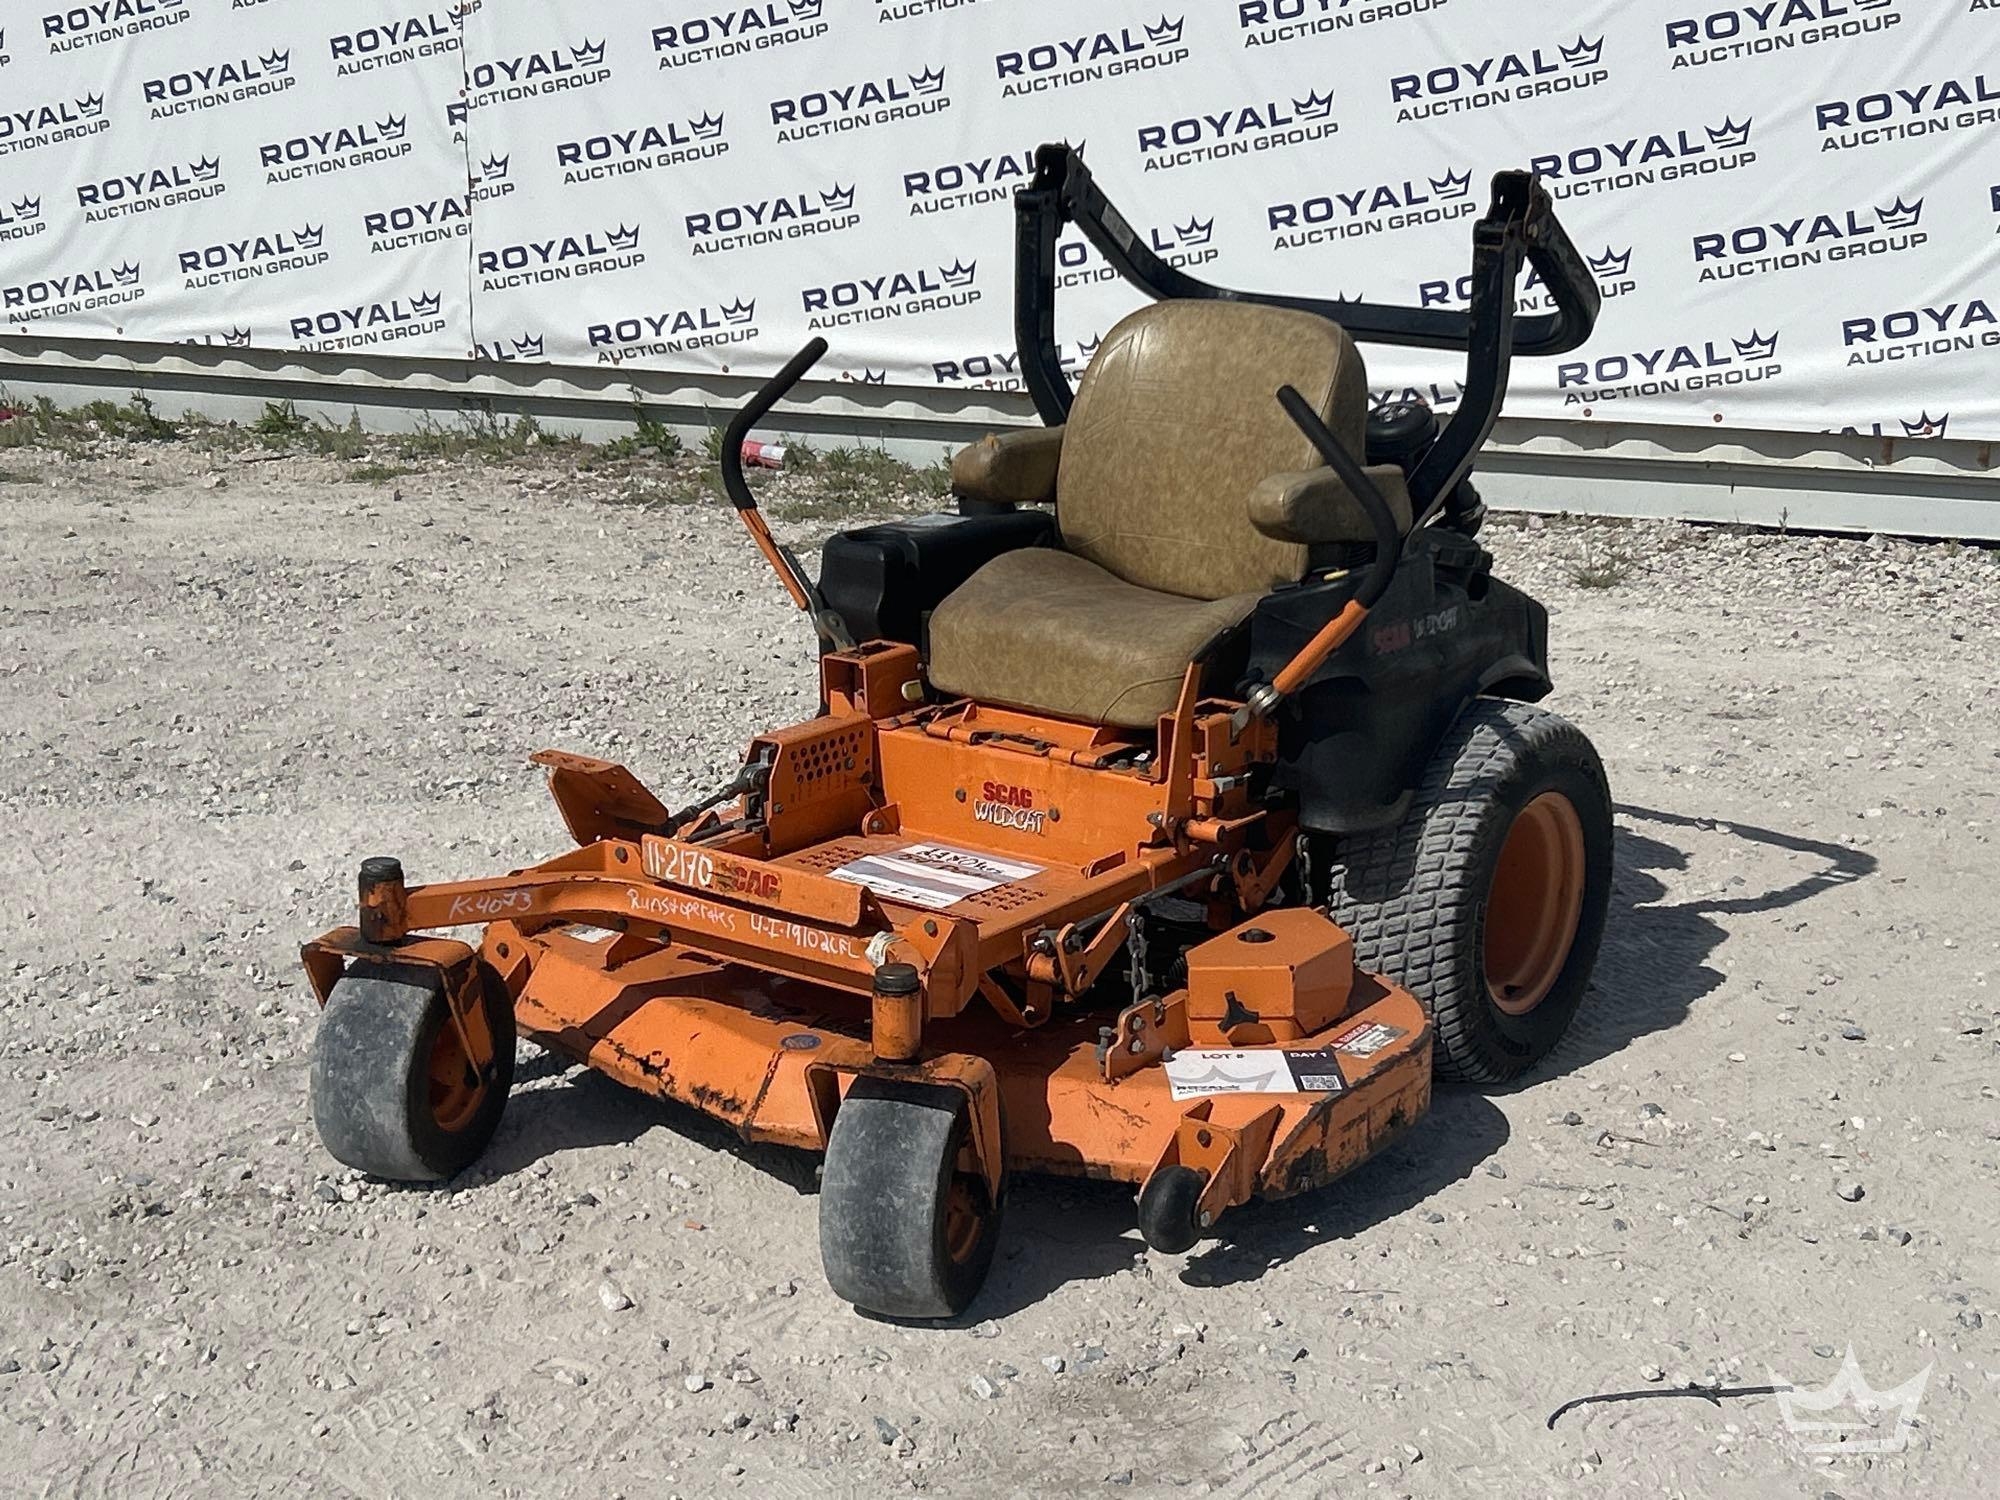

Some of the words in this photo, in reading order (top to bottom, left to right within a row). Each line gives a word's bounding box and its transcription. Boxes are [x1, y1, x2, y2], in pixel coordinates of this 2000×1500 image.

[43, 0, 155, 38] ROYAL
[50, 26, 123, 54] AUCTION
[127, 10, 190, 34] GROUP
[330, 14, 448, 61] ROYAL
[652, 4, 789, 52] ROYAL
[1245, 14, 1353, 48] AUCTION
[1359, 0, 1447, 23] GROUP
[1666, 0, 1847, 50] ROYAL
[338, 48, 414, 77] AUCTION
[419, 36, 463, 57] GRO
[659, 40, 751, 70] AUCTION
[756, 23, 828, 49] GROUP
[996, 29, 1144, 79] ROYAL
[1672, 33, 1794, 70] AUCTION
[1801, 13, 1900, 44] GROUP
[143, 60, 261, 102] ROYAL
[466, 84, 537, 110] UCTION
[542, 69, 610, 93] GROUP
[1003, 66, 1102, 98] AUCTION
[1108, 49, 1188, 76] GROUP
[1391, 49, 1559, 103] ROYAL
[151, 92, 229, 119] AUCTION
[233, 77, 295, 101] GROUP
[771, 78, 909, 125] ROYAL
[1397, 89, 1510, 123] AUCTION
[1516, 70, 1608, 99] GROUP
[1816, 75, 2000, 130] ROYAL
[0, 103, 78, 137] OYAL
[0, 134, 48, 155] CTION
[52, 120, 110, 142] GROUP
[777, 114, 870, 143] AUCTION
[875, 98, 950, 123] GROUP
[1138, 103, 1292, 155] ROYAL
[1822, 117, 1949, 152] AUCTION
[260, 125, 378, 167] ROYAL
[267, 158, 346, 184] AUCTION
[350, 143, 411, 166] GROUP
[557, 123, 690, 167] ROYAL
[564, 157, 652, 184] AUCTION
[657, 143, 729, 166] GROUP
[1145, 140, 1248, 172] AUCTION
[1254, 123, 1338, 150] GROUP
[1531, 130, 1705, 181] ROYAL
[77, 166, 191, 207] ROYAL
[469, 183, 515, 202] ROUP
[1553, 170, 1654, 200] UCTION
[1661, 152, 1756, 180] GROUP
[86, 198, 160, 223] AUCTION
[164, 184, 225, 206] GROUP
[686, 195, 820, 238] ROYAL
[910, 187, 1007, 216] AUCTION
[1268, 182, 1429, 231] ROYAL
[0, 223, 45, 241] ROUP
[372, 227, 452, 253] AUCTION
[693, 229, 783, 255] AUCTION
[787, 215, 860, 238] GROUP
[1274, 219, 1382, 250] AUCTION
[1388, 203, 1476, 229] GROUP
[1693, 211, 1874, 261] ROYAL
[179, 234, 294, 273] ROYAL
[185, 265, 263, 289] AUCTION
[266, 252, 328, 273] GROUP
[479, 234, 606, 275] ROYAL
[483, 267, 570, 291] AUCTION
[575, 254, 645, 276] GROUP
[1699, 250, 1821, 282] AUCTION
[1828, 233, 1927, 260] GROUP
[3, 271, 113, 308] ROYAL
[9, 302, 80, 324] AUCTION
[85, 289, 144, 309] GROUP
[802, 270, 940, 313] ROYAL
[290, 301, 411, 339] ROYAL
[382, 320, 445, 340] GROUP
[588, 308, 720, 349] ROYAL
[809, 304, 901, 330] AUCTION
[906, 291, 981, 313] GROUP
[599, 340, 682, 364] AUCTION
[686, 328, 758, 349] GROUP
[932, 345, 1075, 383] ROYL
[1559, 342, 1731, 390] ROYAL
[1847, 335, 1974, 366] AUCTION
[1565, 379, 1680, 405] AUCTION
[1686, 365, 1781, 390] GROUP
[983, 781, 1032, 808] SCAG
[974, 798, 1045, 835] WILDCAT
